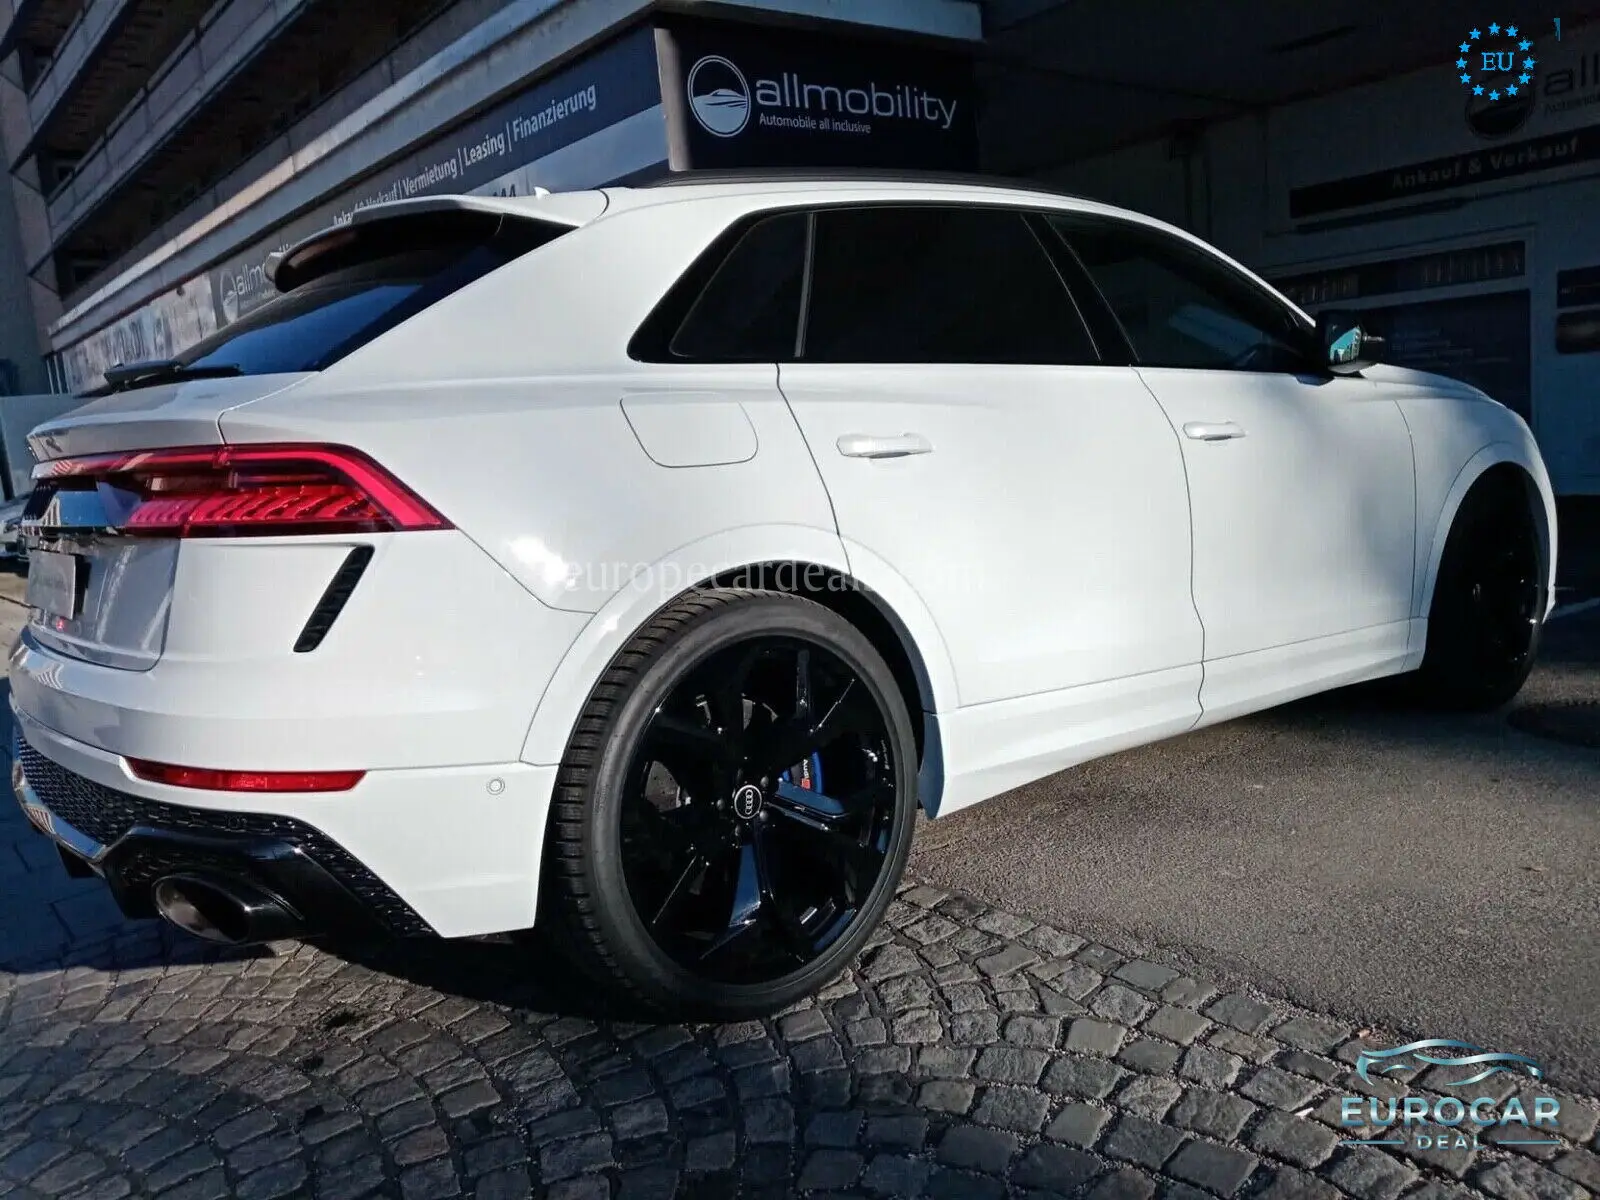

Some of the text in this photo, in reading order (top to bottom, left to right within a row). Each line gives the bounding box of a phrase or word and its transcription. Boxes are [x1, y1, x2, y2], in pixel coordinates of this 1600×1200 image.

[756, 73, 957, 129] allmobility
[759, 112, 871, 134] Automobile all inclusive
[402, 158, 458, 196] Vermietung
[463, 131, 505, 166] Leasing
[512, 84, 596, 142] Finanzierung
[1490, 135, 1579, 170] Verkauf
